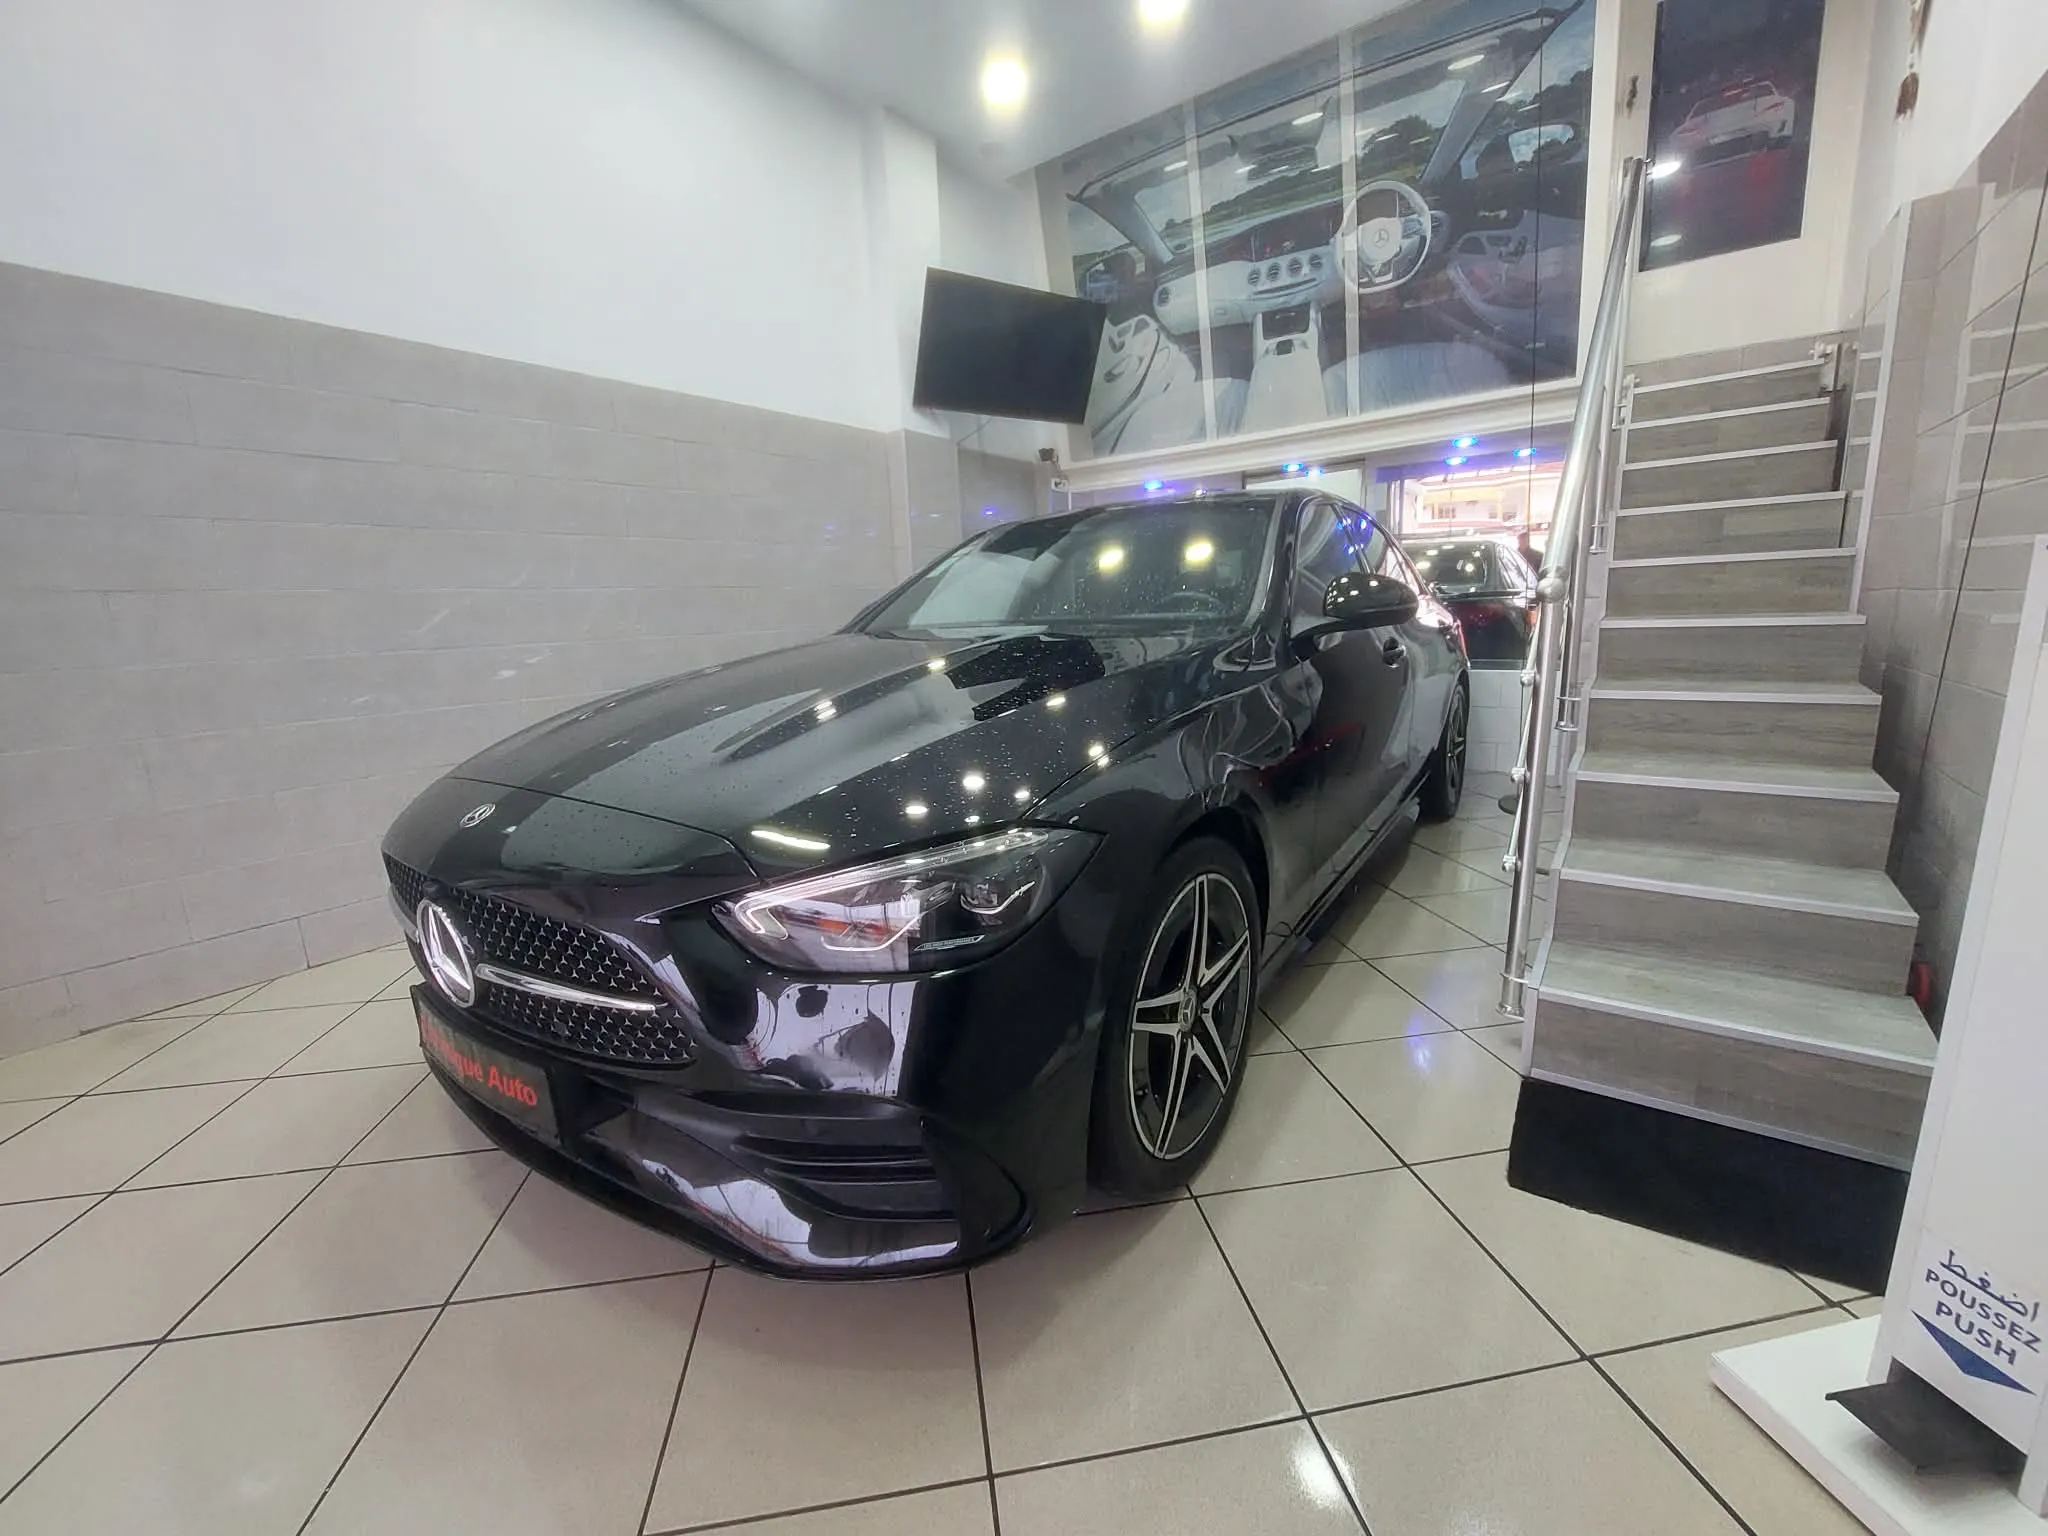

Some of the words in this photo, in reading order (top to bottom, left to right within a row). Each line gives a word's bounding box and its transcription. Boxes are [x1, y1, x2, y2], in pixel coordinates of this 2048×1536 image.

[488, 1065, 537, 1106] Auto
[1925, 1268, 2042, 1353] POUSSEZ
[1938, 1249, 2040, 1322] اضغط
[1935, 1300, 2017, 1366] PUSH
